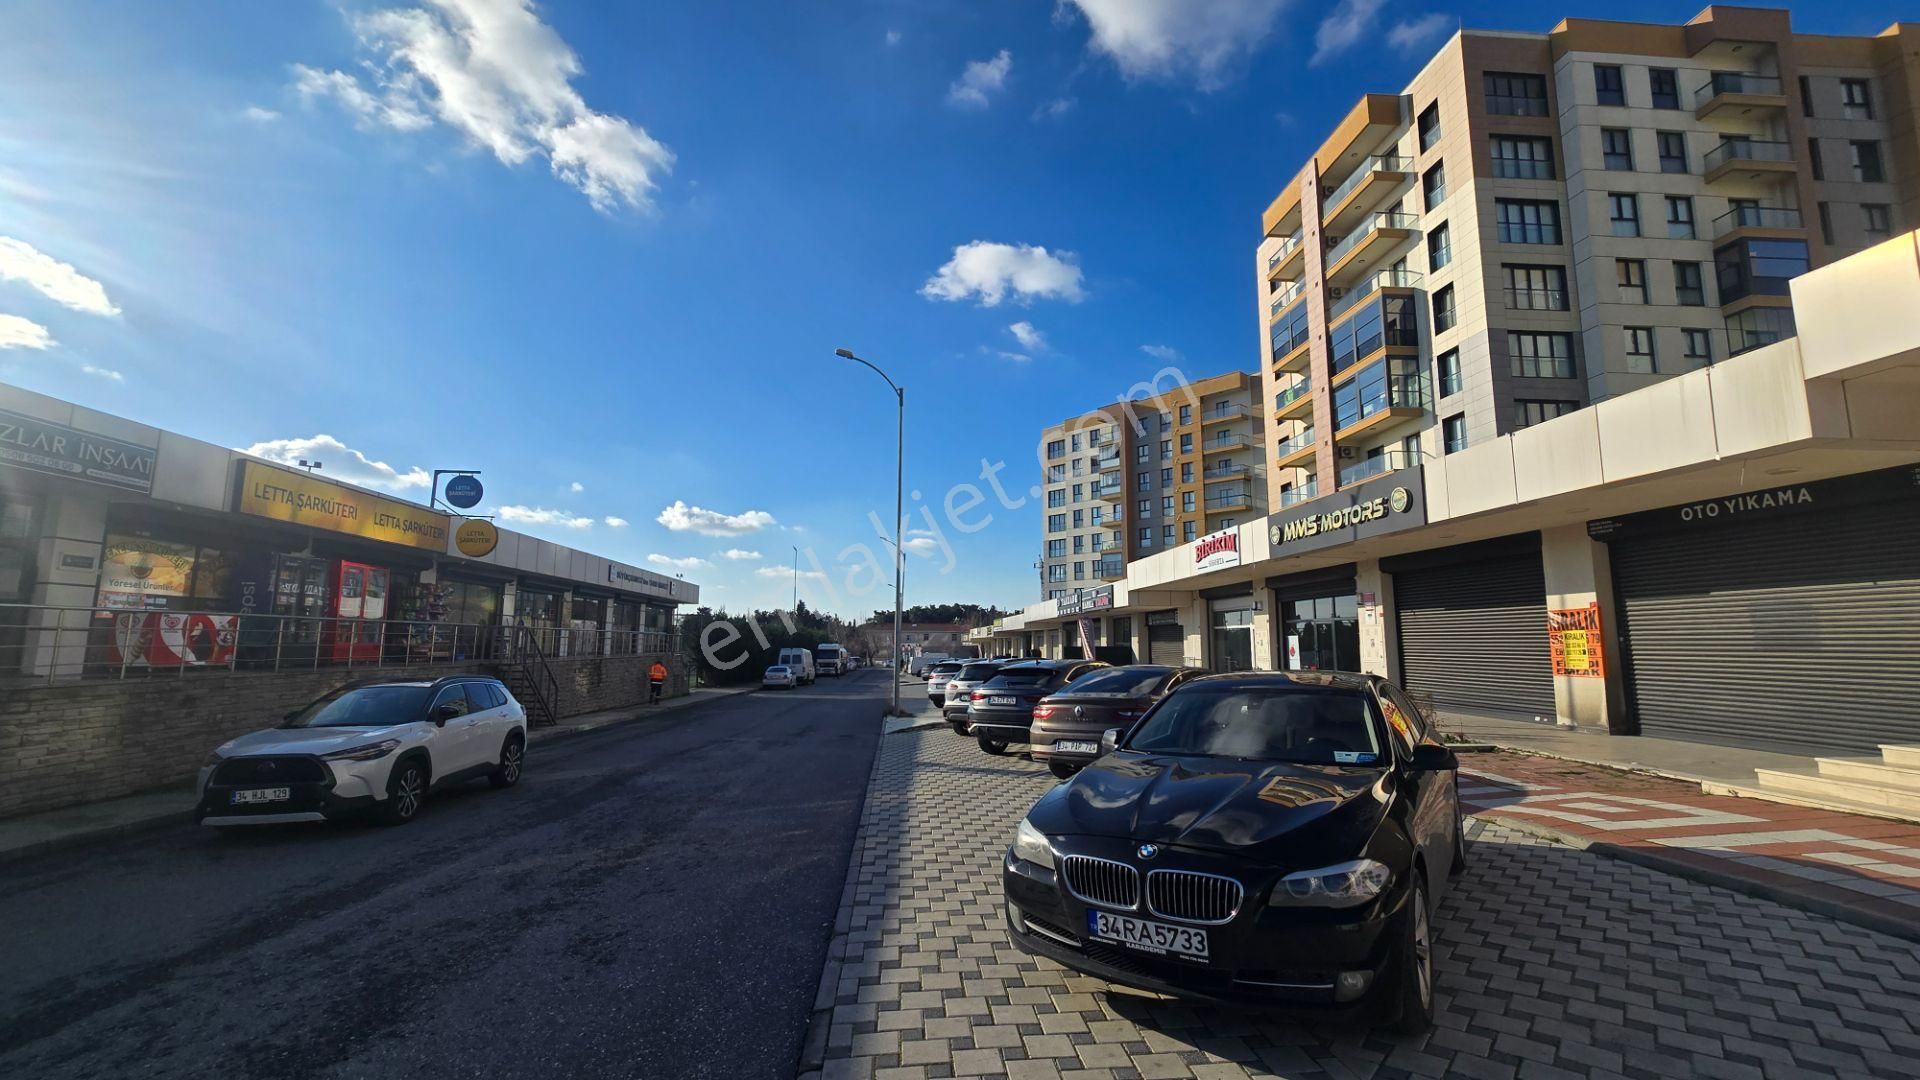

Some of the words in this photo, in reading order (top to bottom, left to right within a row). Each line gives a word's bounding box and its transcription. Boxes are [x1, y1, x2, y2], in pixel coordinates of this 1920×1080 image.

[254, 482, 295, 505] LETTA
[296, 492, 359, 521] ŞARKÜTERİ
[1680, 502, 1720, 521] OTO
[1724, 486, 1813, 514] YIKAMA
[373, 511, 401, 530] LETTA
[401, 518, 446, 542] ŞARKÜTERİ
[1283, 513, 1319, 542] MMS
[1320, 497, 1385, 533] MOTORS
[1195, 531, 1238, 563] BİRİKİM
[237, 793, 247, 801] 34
[272, 789, 287, 799] 129
